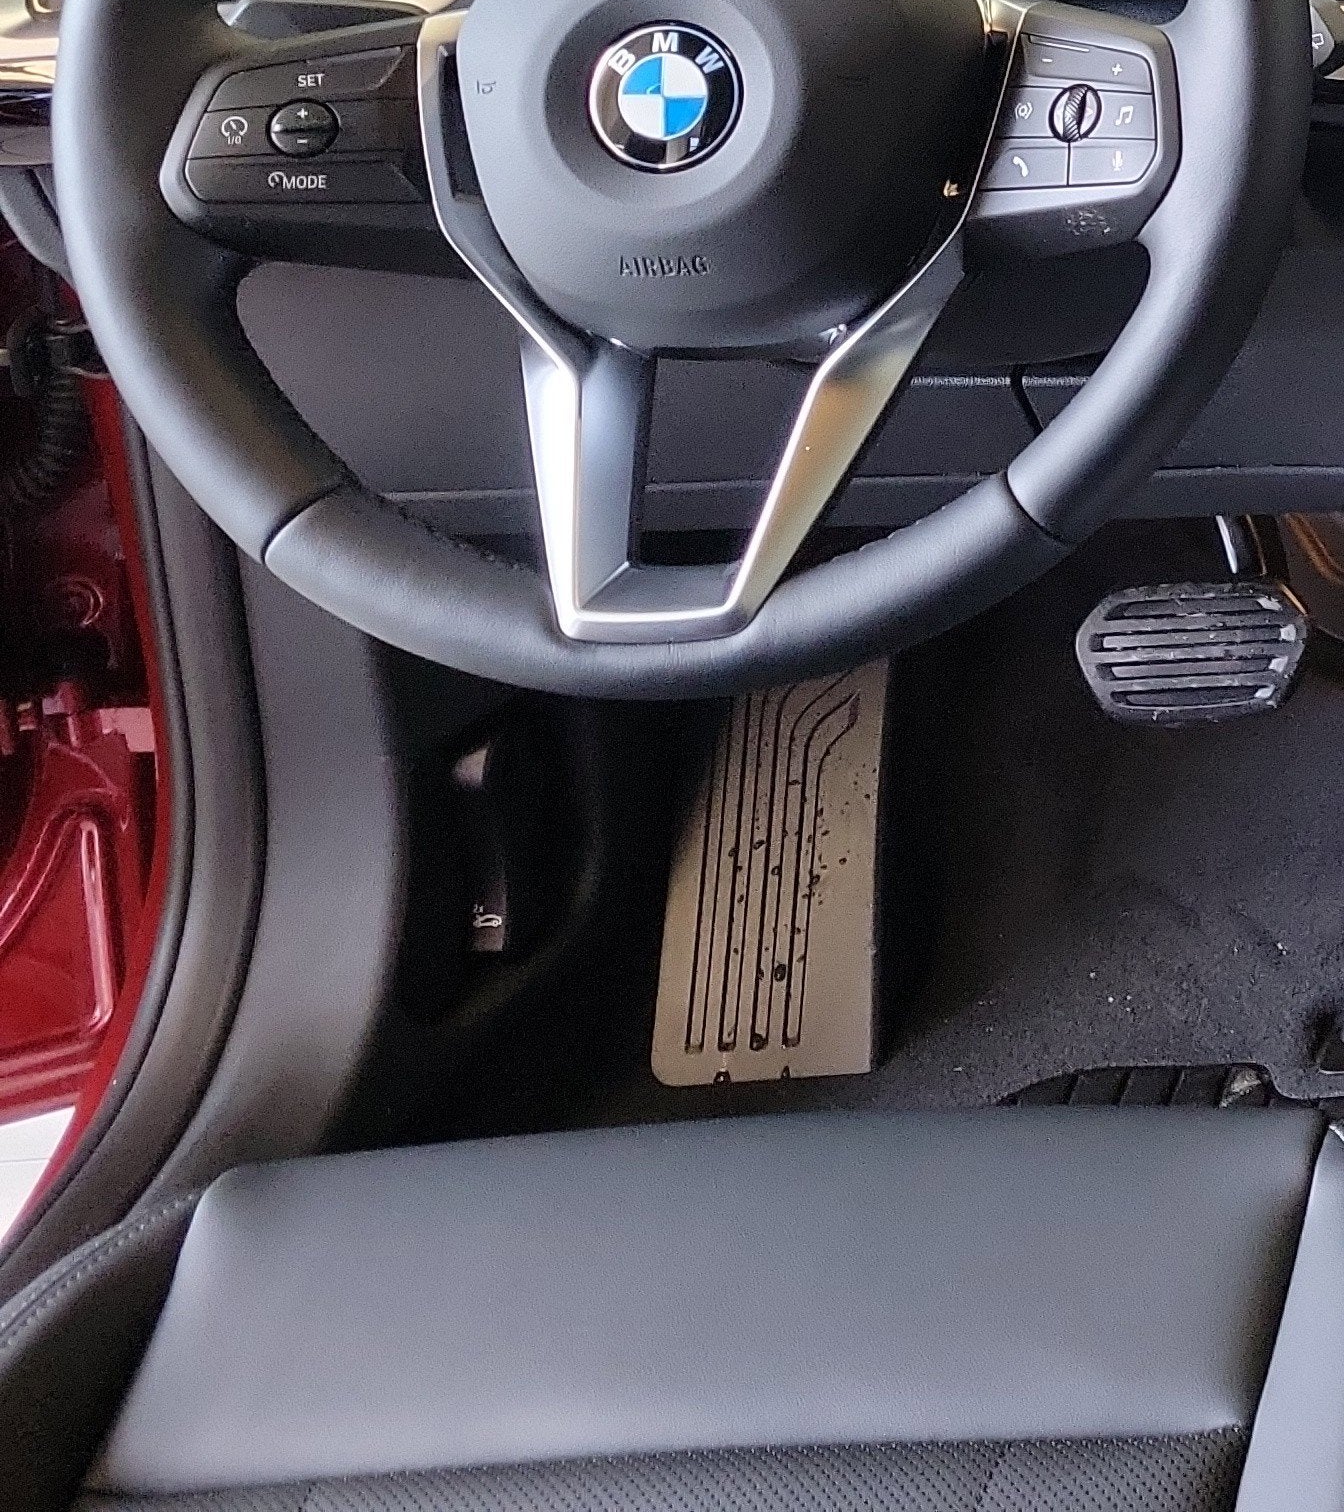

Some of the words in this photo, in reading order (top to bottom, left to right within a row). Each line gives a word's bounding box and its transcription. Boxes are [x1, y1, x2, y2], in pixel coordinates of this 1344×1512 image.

[607, 31, 725, 76] BMW
[297, 73, 325, 87] SET
[282, 175, 327, 189] MODE
[619, 254, 711, 276] AIRBAG
